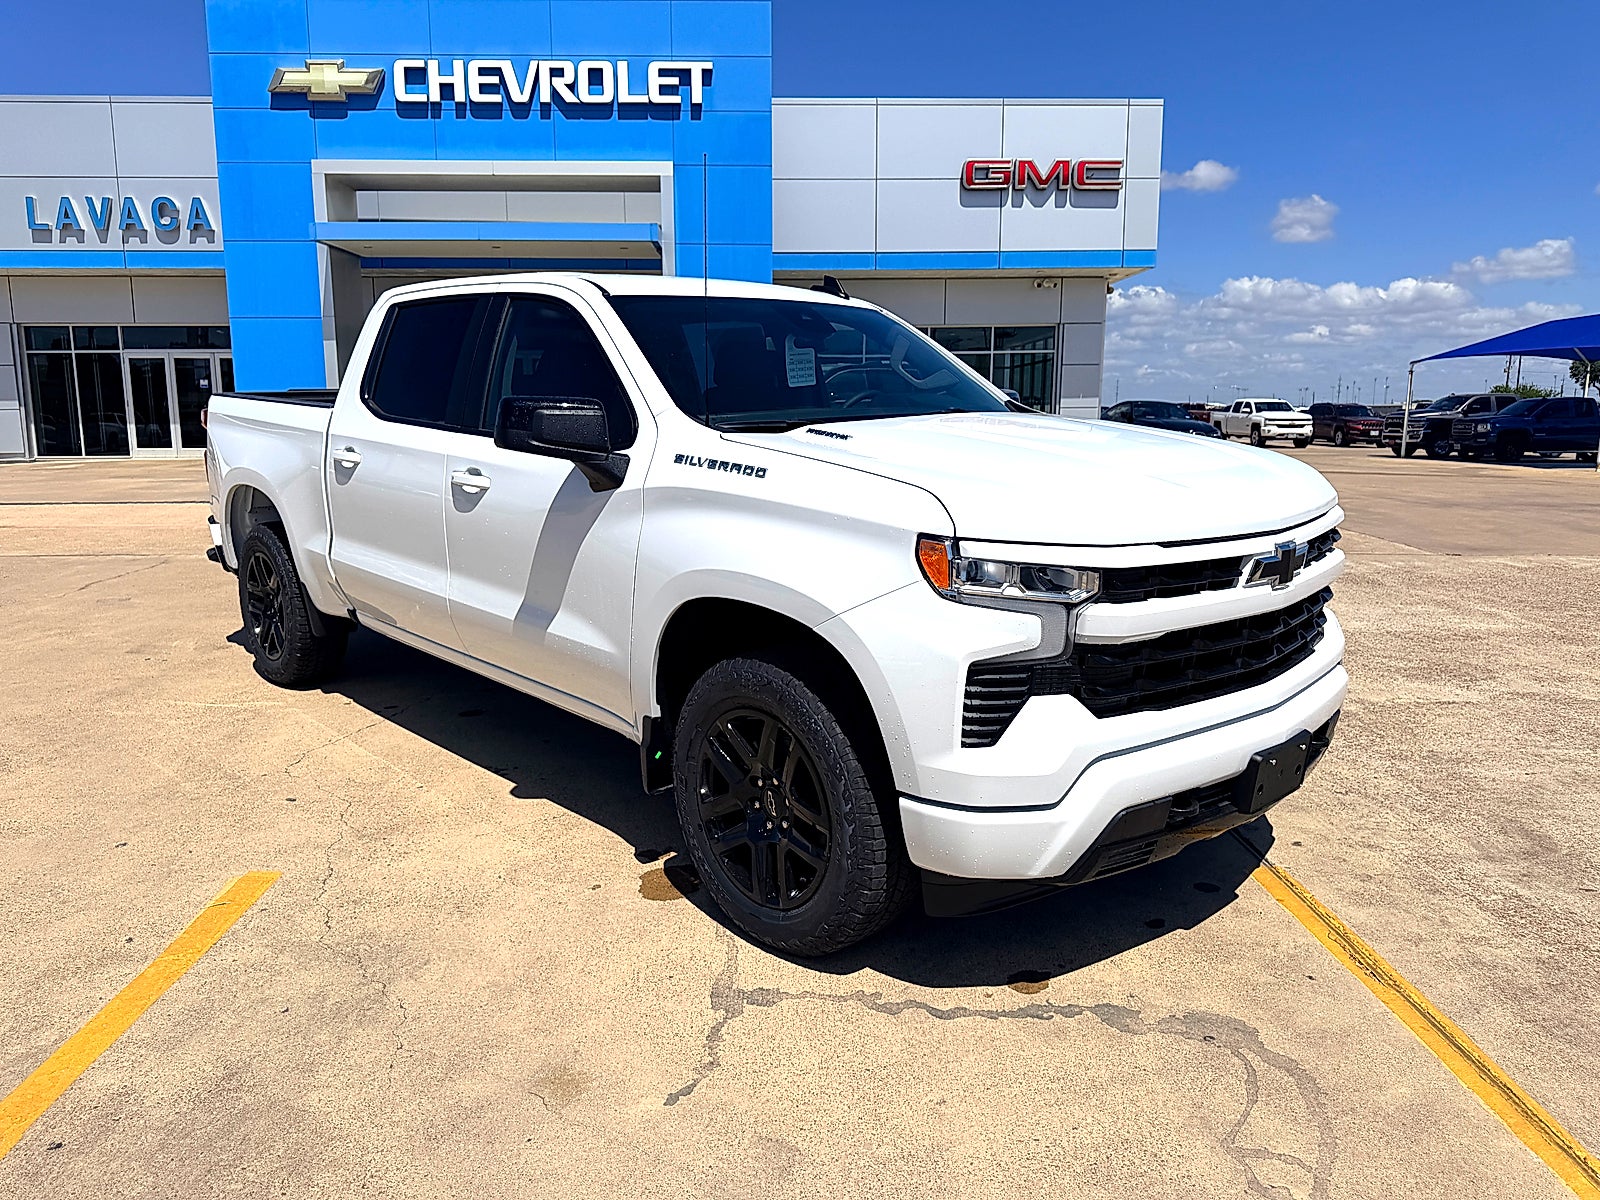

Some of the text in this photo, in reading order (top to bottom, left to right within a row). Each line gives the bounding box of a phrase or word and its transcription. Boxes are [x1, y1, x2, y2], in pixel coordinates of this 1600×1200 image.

[393, 59, 714, 104] CHEVROLET
[962, 158, 1124, 190] GMC
[25, 196, 214, 231] LAVACA
[673, 453, 767, 479] SILVERADO
